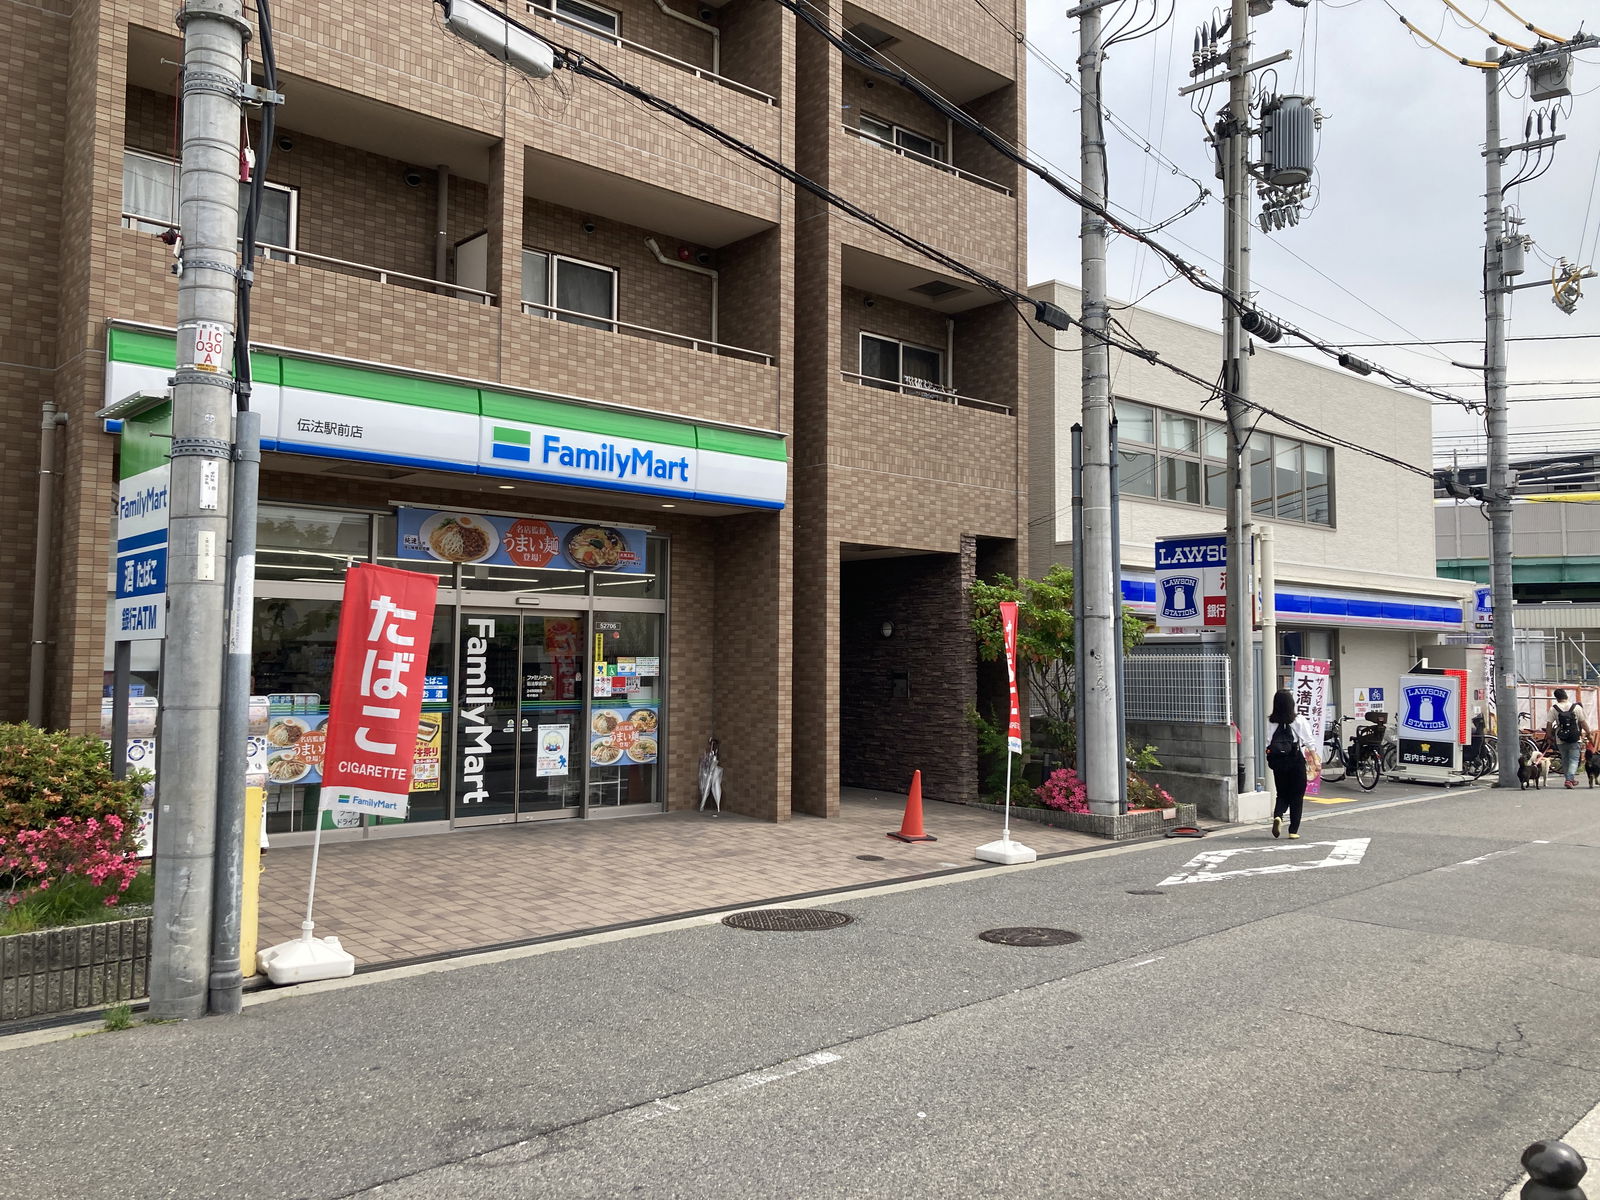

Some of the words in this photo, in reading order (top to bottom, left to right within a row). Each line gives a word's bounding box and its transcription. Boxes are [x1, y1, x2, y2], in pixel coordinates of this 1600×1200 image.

[196, 341, 222, 354] 030
[204, 353, 212, 364] A
[297, 418, 363, 438] 伝法駅前店
[543, 434, 689, 482] FamilyMart
[119, 484, 168, 520] FamilyMart
[516, 525, 547, 535] 名店監修
[503, 533, 560, 555] うまい麺
[123, 560, 135, 593] 酒
[136, 558, 158, 589] たばこ
[1163, 578, 1196, 587] LAWSON
[121, 604, 157, 631] 銀行ATM
[1163, 607, 1196, 617] STATION
[355, 595, 417, 755] たばこ
[1301, 664, 1325, 674] 新登場!
[1407, 688, 1447, 698] LAWSON
[461, 618, 496, 804] FamilyMart
[1407, 718, 1446, 729] STATION
[1403, 753, 1449, 764] 店内キッチン
[338, 760, 407, 780] CIGARETTE
[352, 796, 398, 810] FamilyMart
